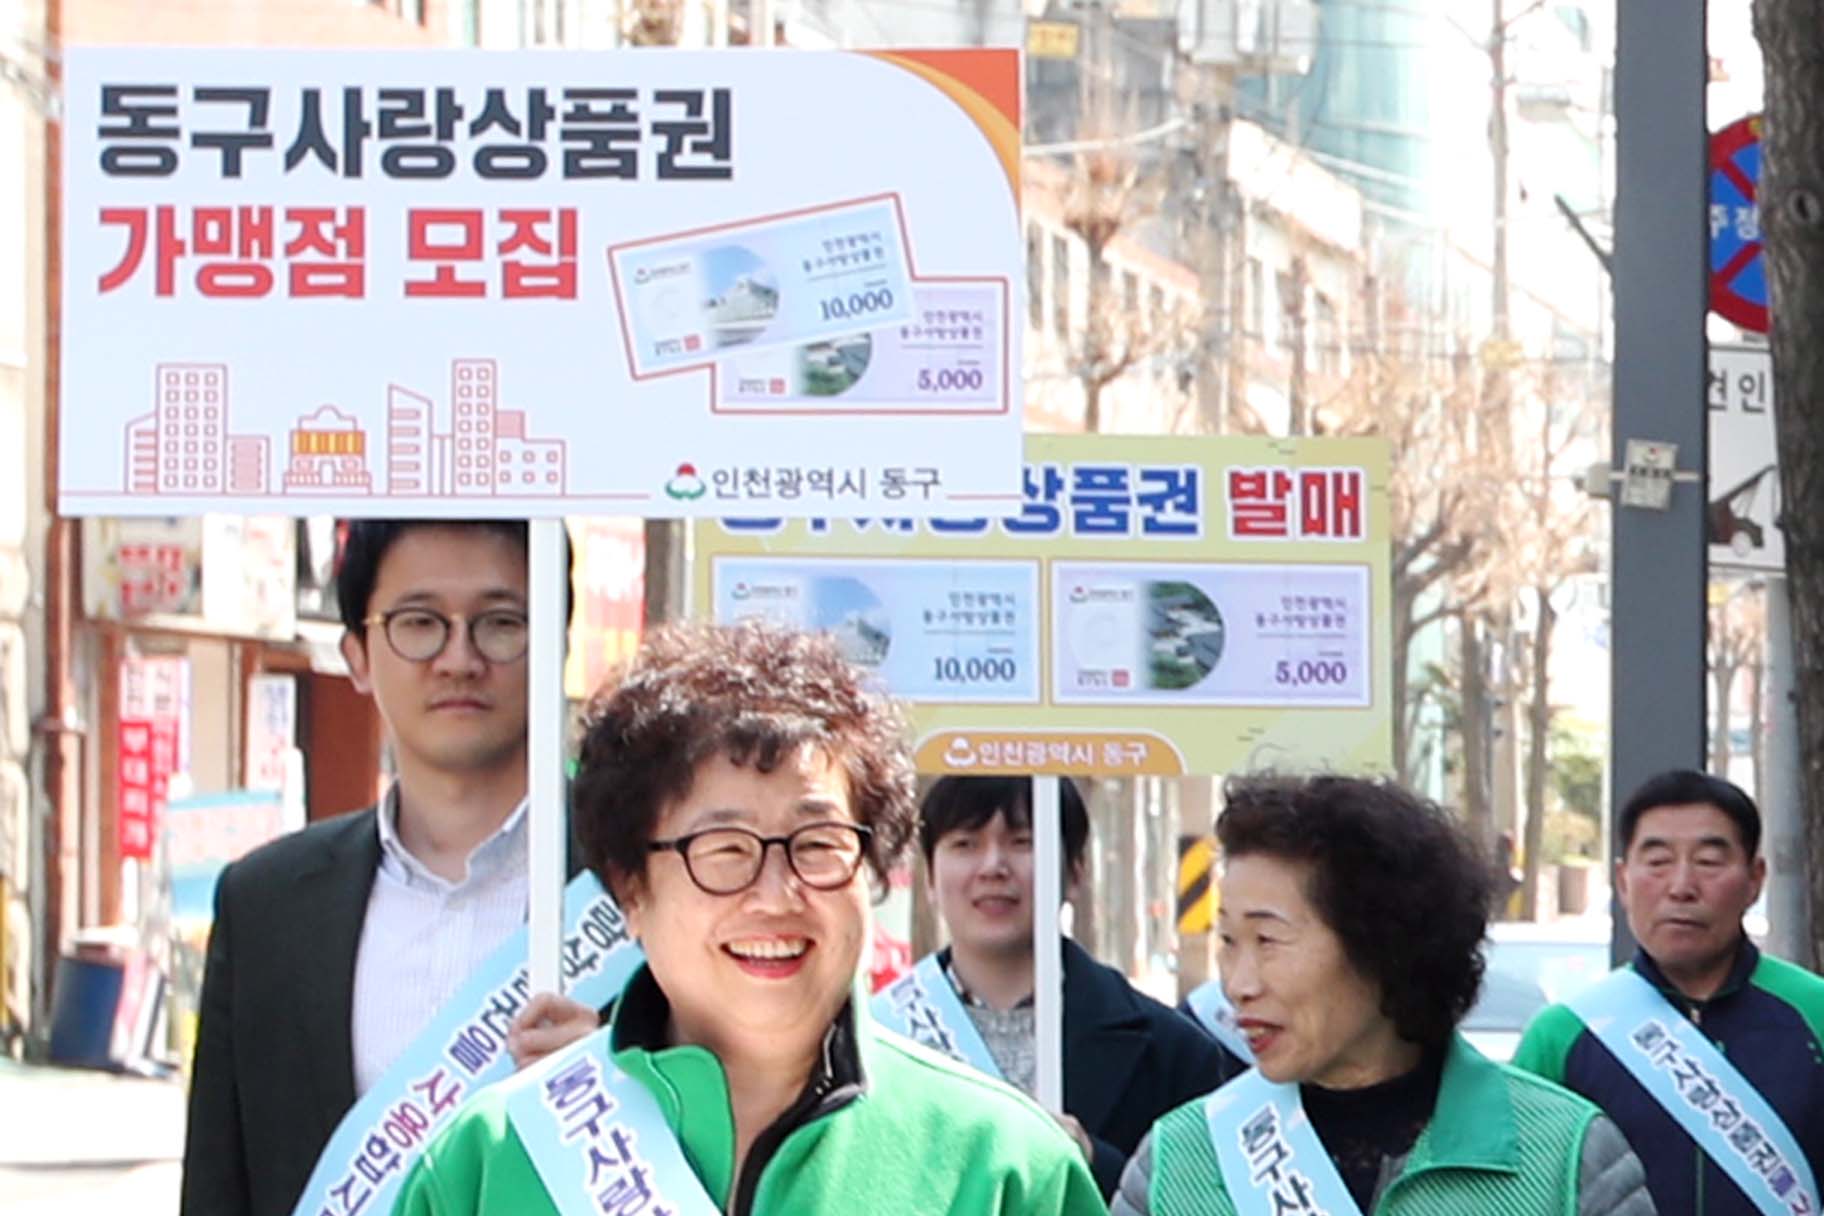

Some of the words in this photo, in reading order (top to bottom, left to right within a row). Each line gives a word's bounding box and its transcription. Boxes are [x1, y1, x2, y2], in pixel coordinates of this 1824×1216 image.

[98, 84, 733, 181] 동구사랑상품권
[98, 205, 365, 299] 가맹점
[404, 207, 577, 299] 모집
[821, 288, 893, 320] 10,000
[918, 369, 982, 390] 5,000
[712, 469, 866, 500] 인천광역시
[879, 469, 942, 500] 동구
[1228, 471, 1361, 537] 발매
[934, 656, 1017, 683] 10,000
[1274, 660, 1347, 686] 5,000
[979, 738, 1095, 767] 인천광역시
[1103, 739, 1147, 767] 동구
